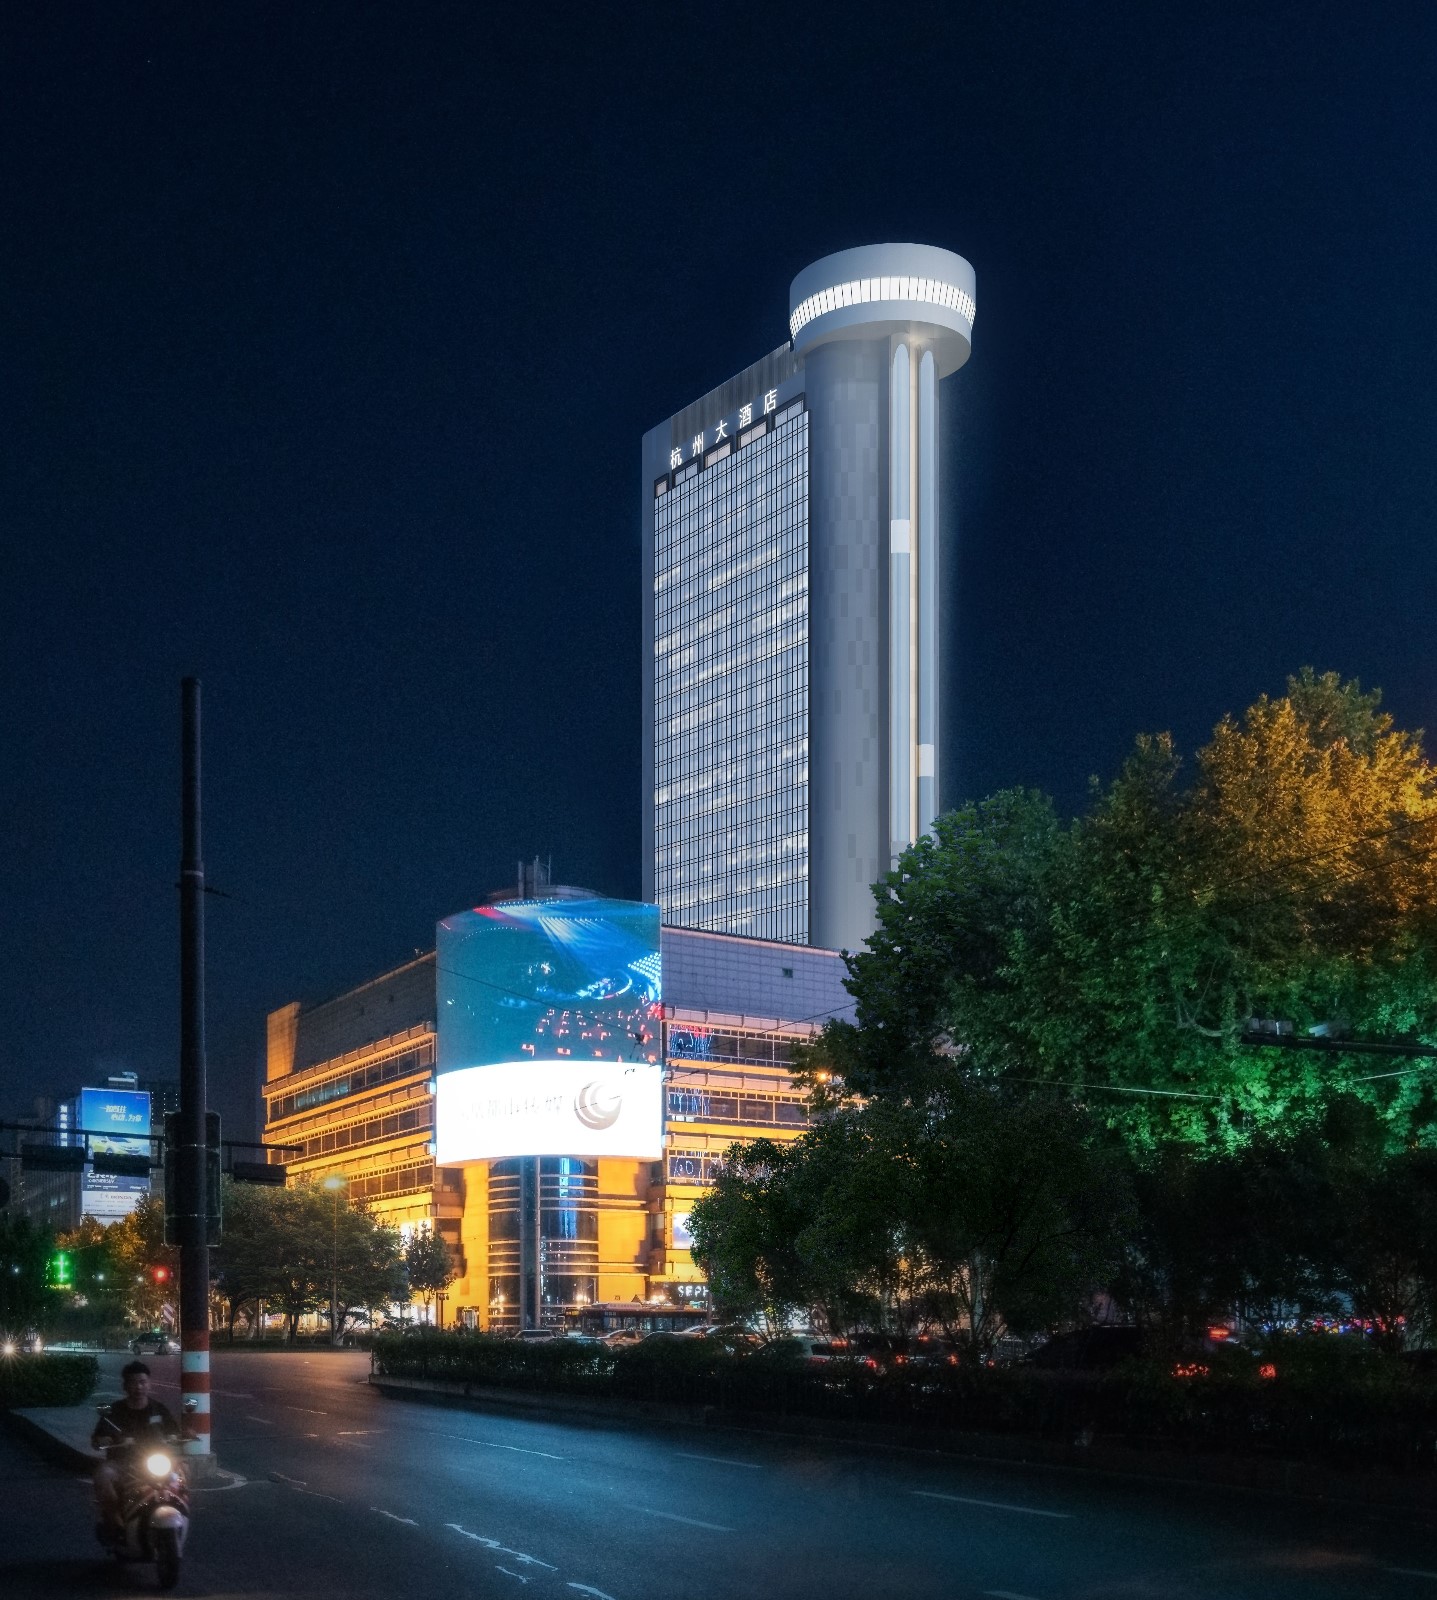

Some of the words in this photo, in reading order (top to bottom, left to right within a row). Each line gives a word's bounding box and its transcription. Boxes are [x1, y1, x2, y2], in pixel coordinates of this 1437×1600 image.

[670, 388, 778, 470] 杭州大酒店
